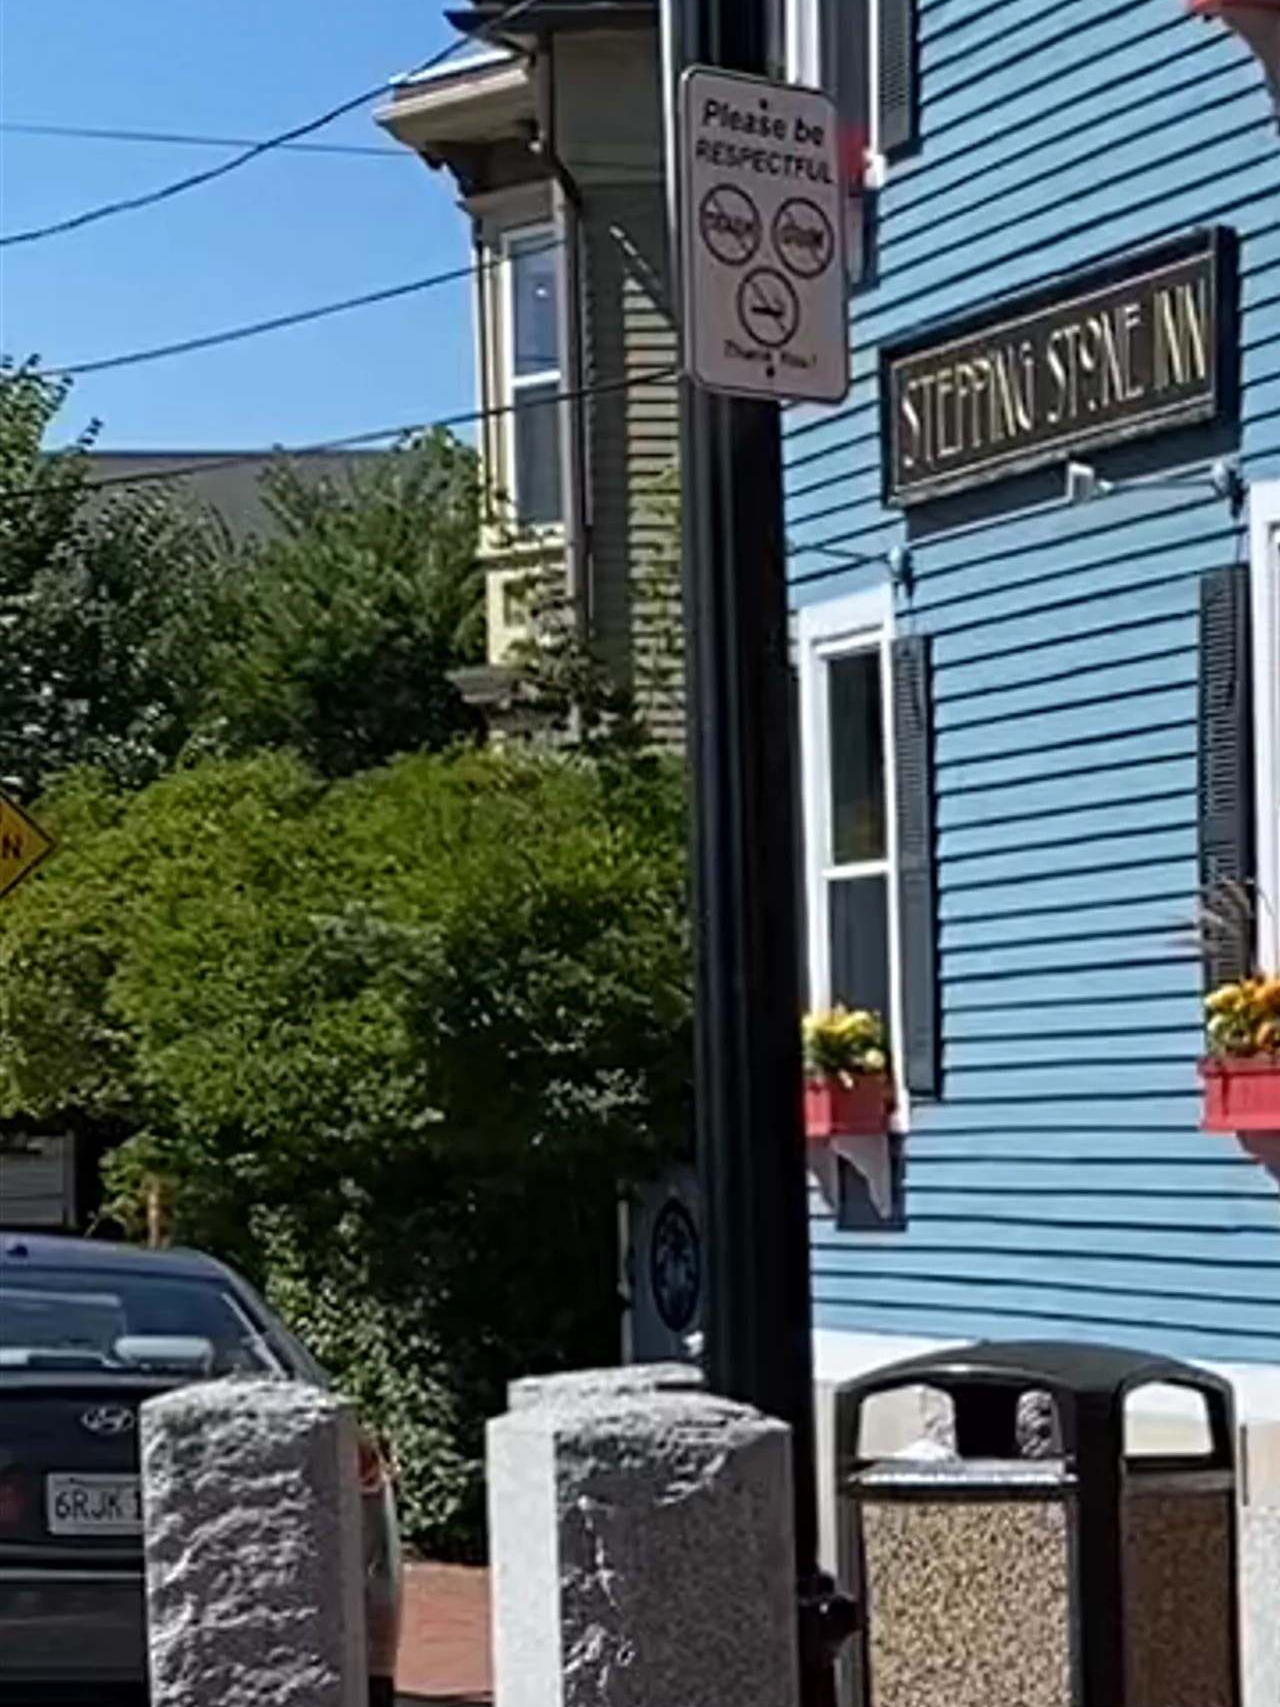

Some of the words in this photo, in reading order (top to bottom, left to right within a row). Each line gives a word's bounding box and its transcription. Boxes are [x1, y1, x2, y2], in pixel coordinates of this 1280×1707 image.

[703, 98, 787, 141] Please
[794, 116, 825, 148] be
[695, 136, 836, 184] RESPECTFUL
[902, 342, 1035, 469] STEPPING
[1046, 303, 1145, 424] STONE
[1154, 277, 1208, 392] INN
[56, 1488, 124, 1519] 6RJK
